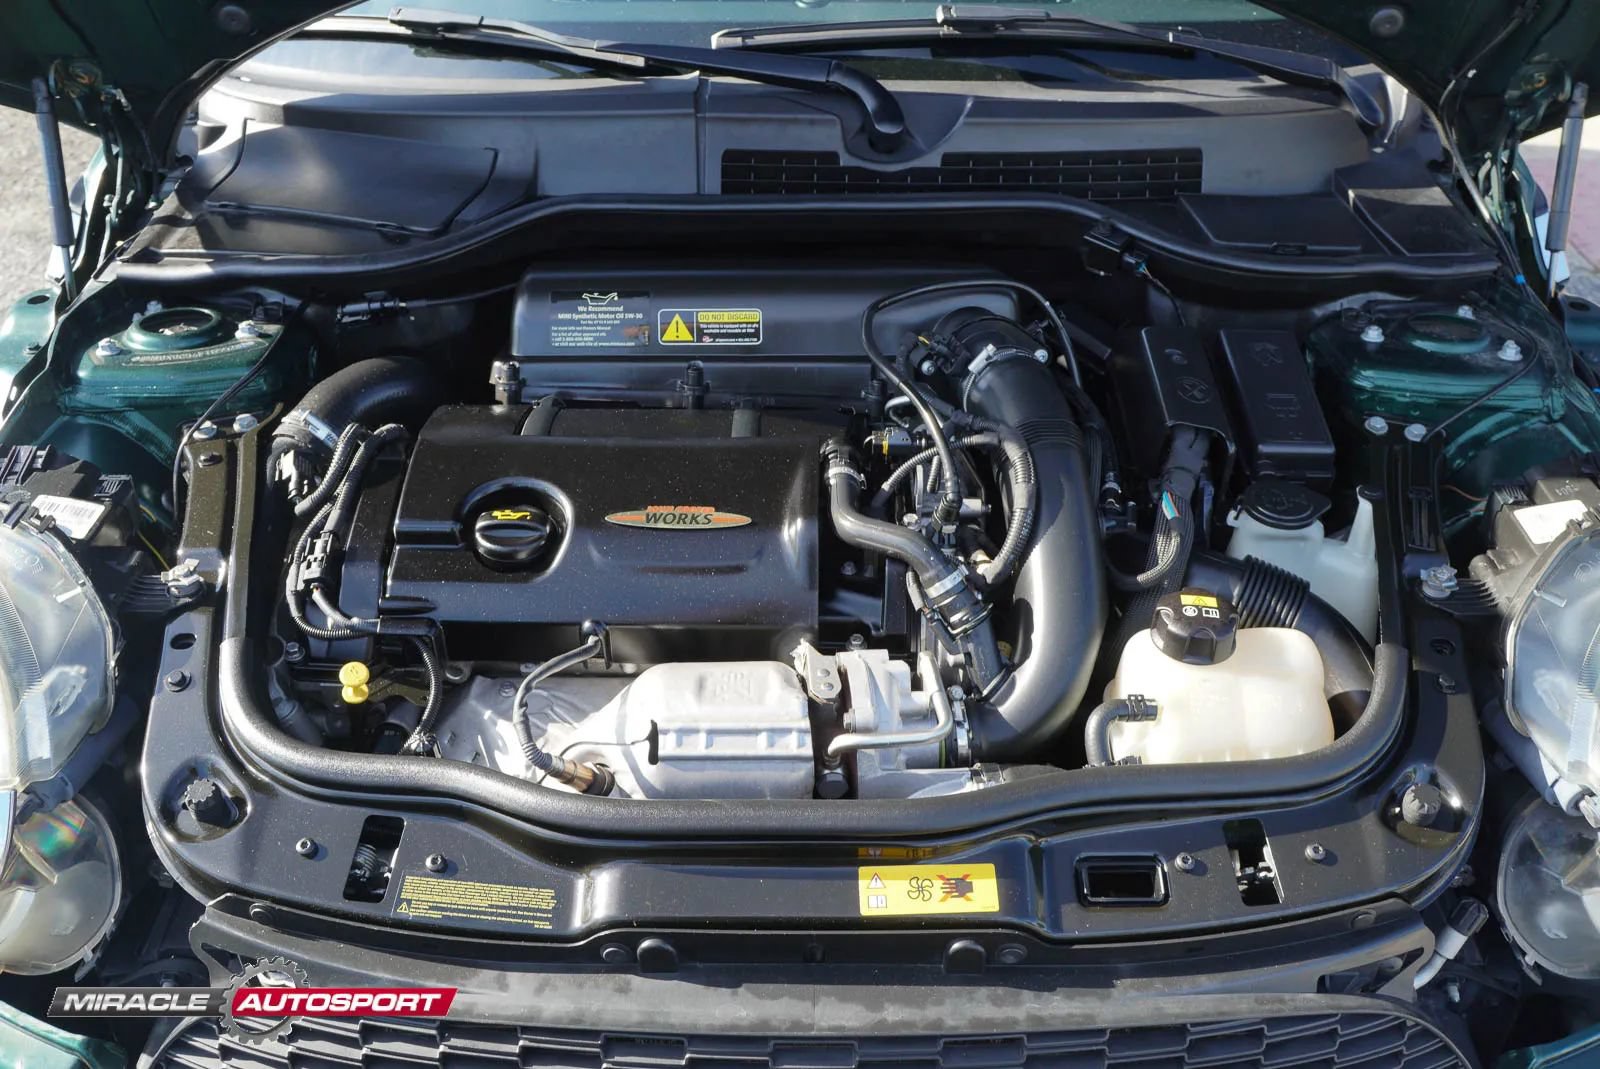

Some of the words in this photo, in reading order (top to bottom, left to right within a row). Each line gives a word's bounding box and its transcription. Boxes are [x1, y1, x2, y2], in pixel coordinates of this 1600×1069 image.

[699, 313, 710, 321] DO
[711, 313, 725, 321] NOT
[645, 512, 713, 525] WORKS
